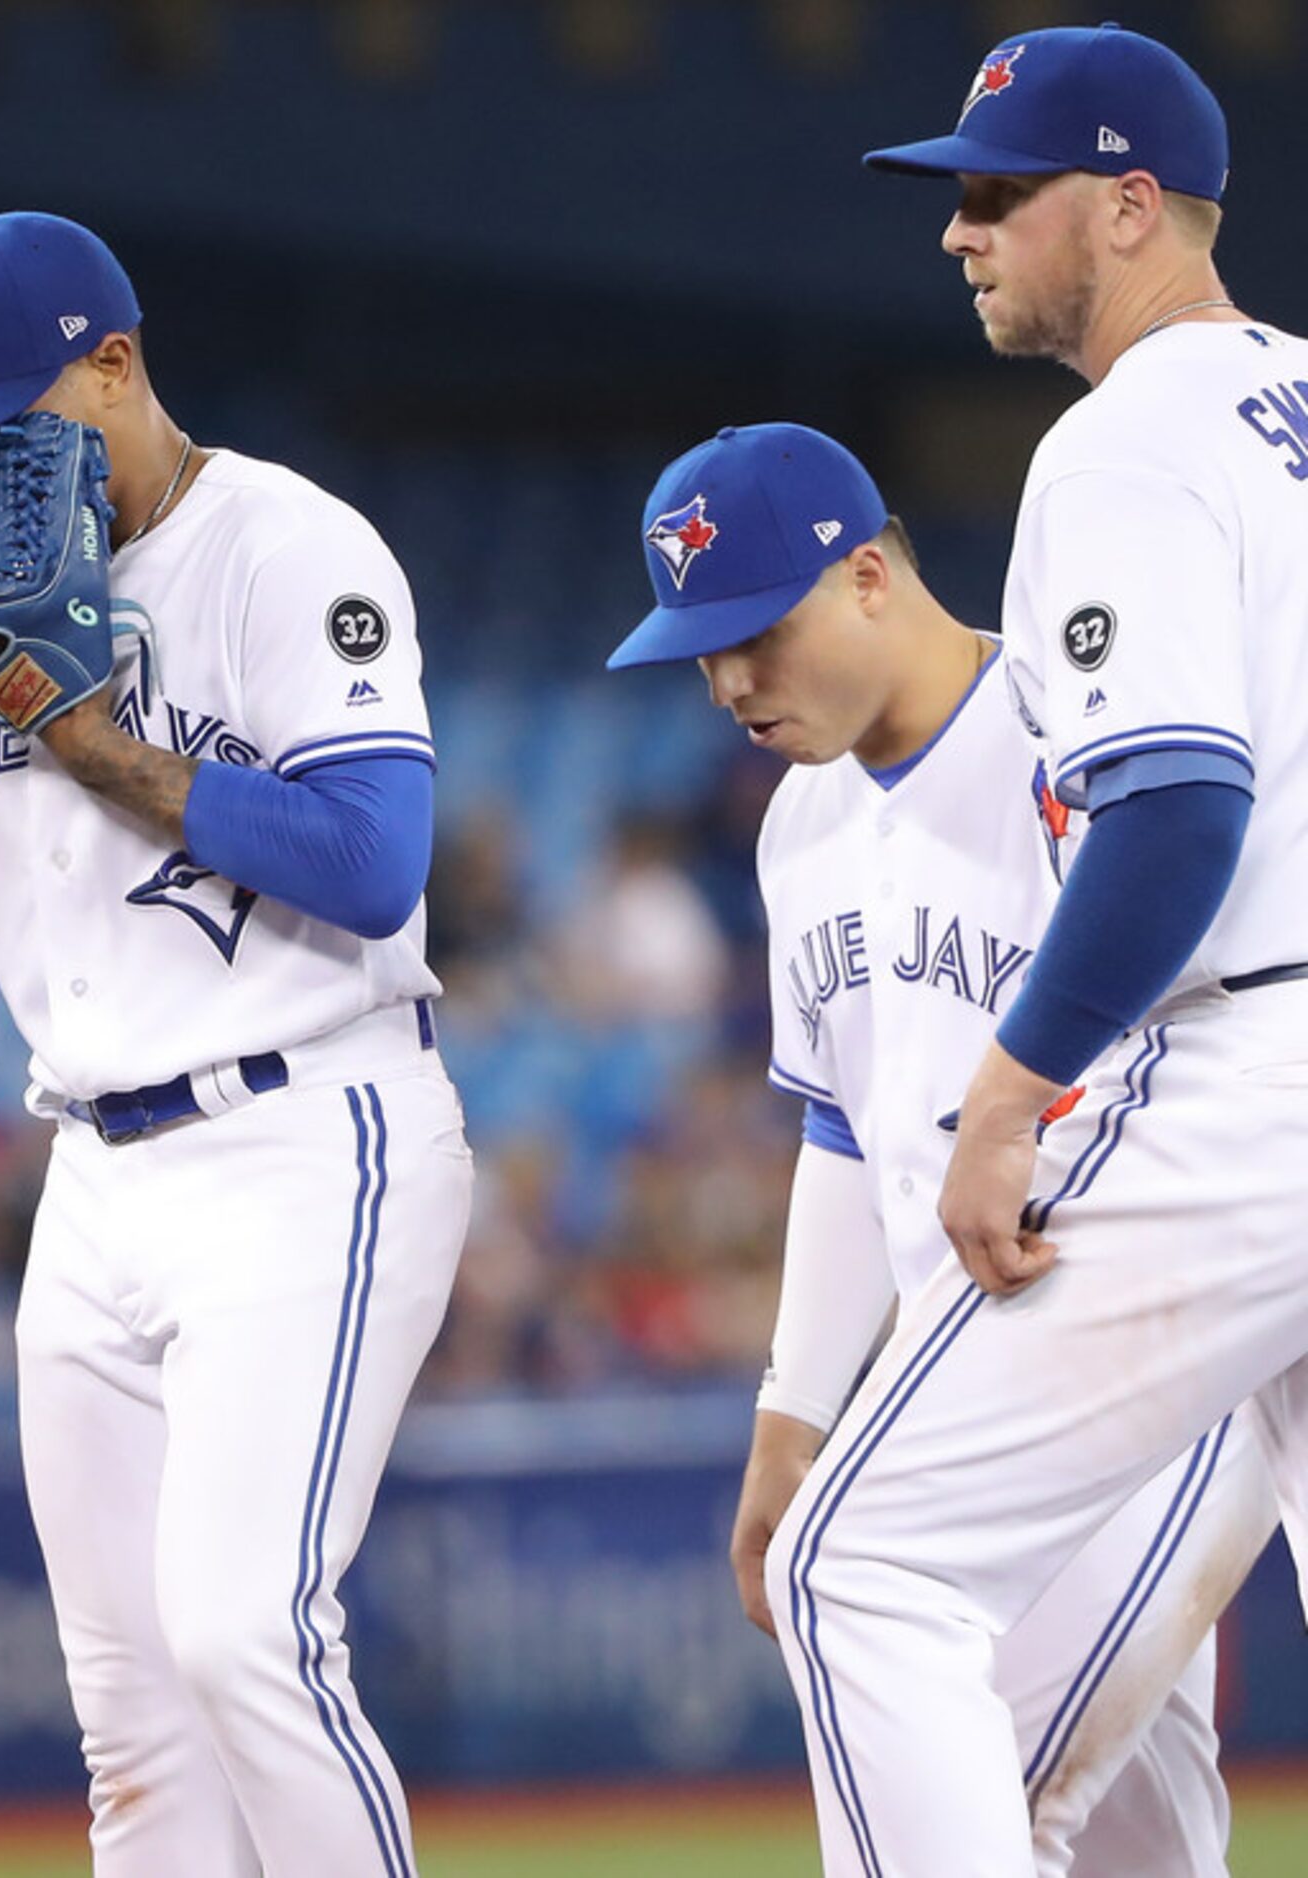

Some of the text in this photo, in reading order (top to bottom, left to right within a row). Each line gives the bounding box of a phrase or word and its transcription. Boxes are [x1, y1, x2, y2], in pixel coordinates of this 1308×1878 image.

[336, 611, 380, 645] 32
[1069, 617, 1106, 655] 32
[892, 906, 1034, 1016] JAY
